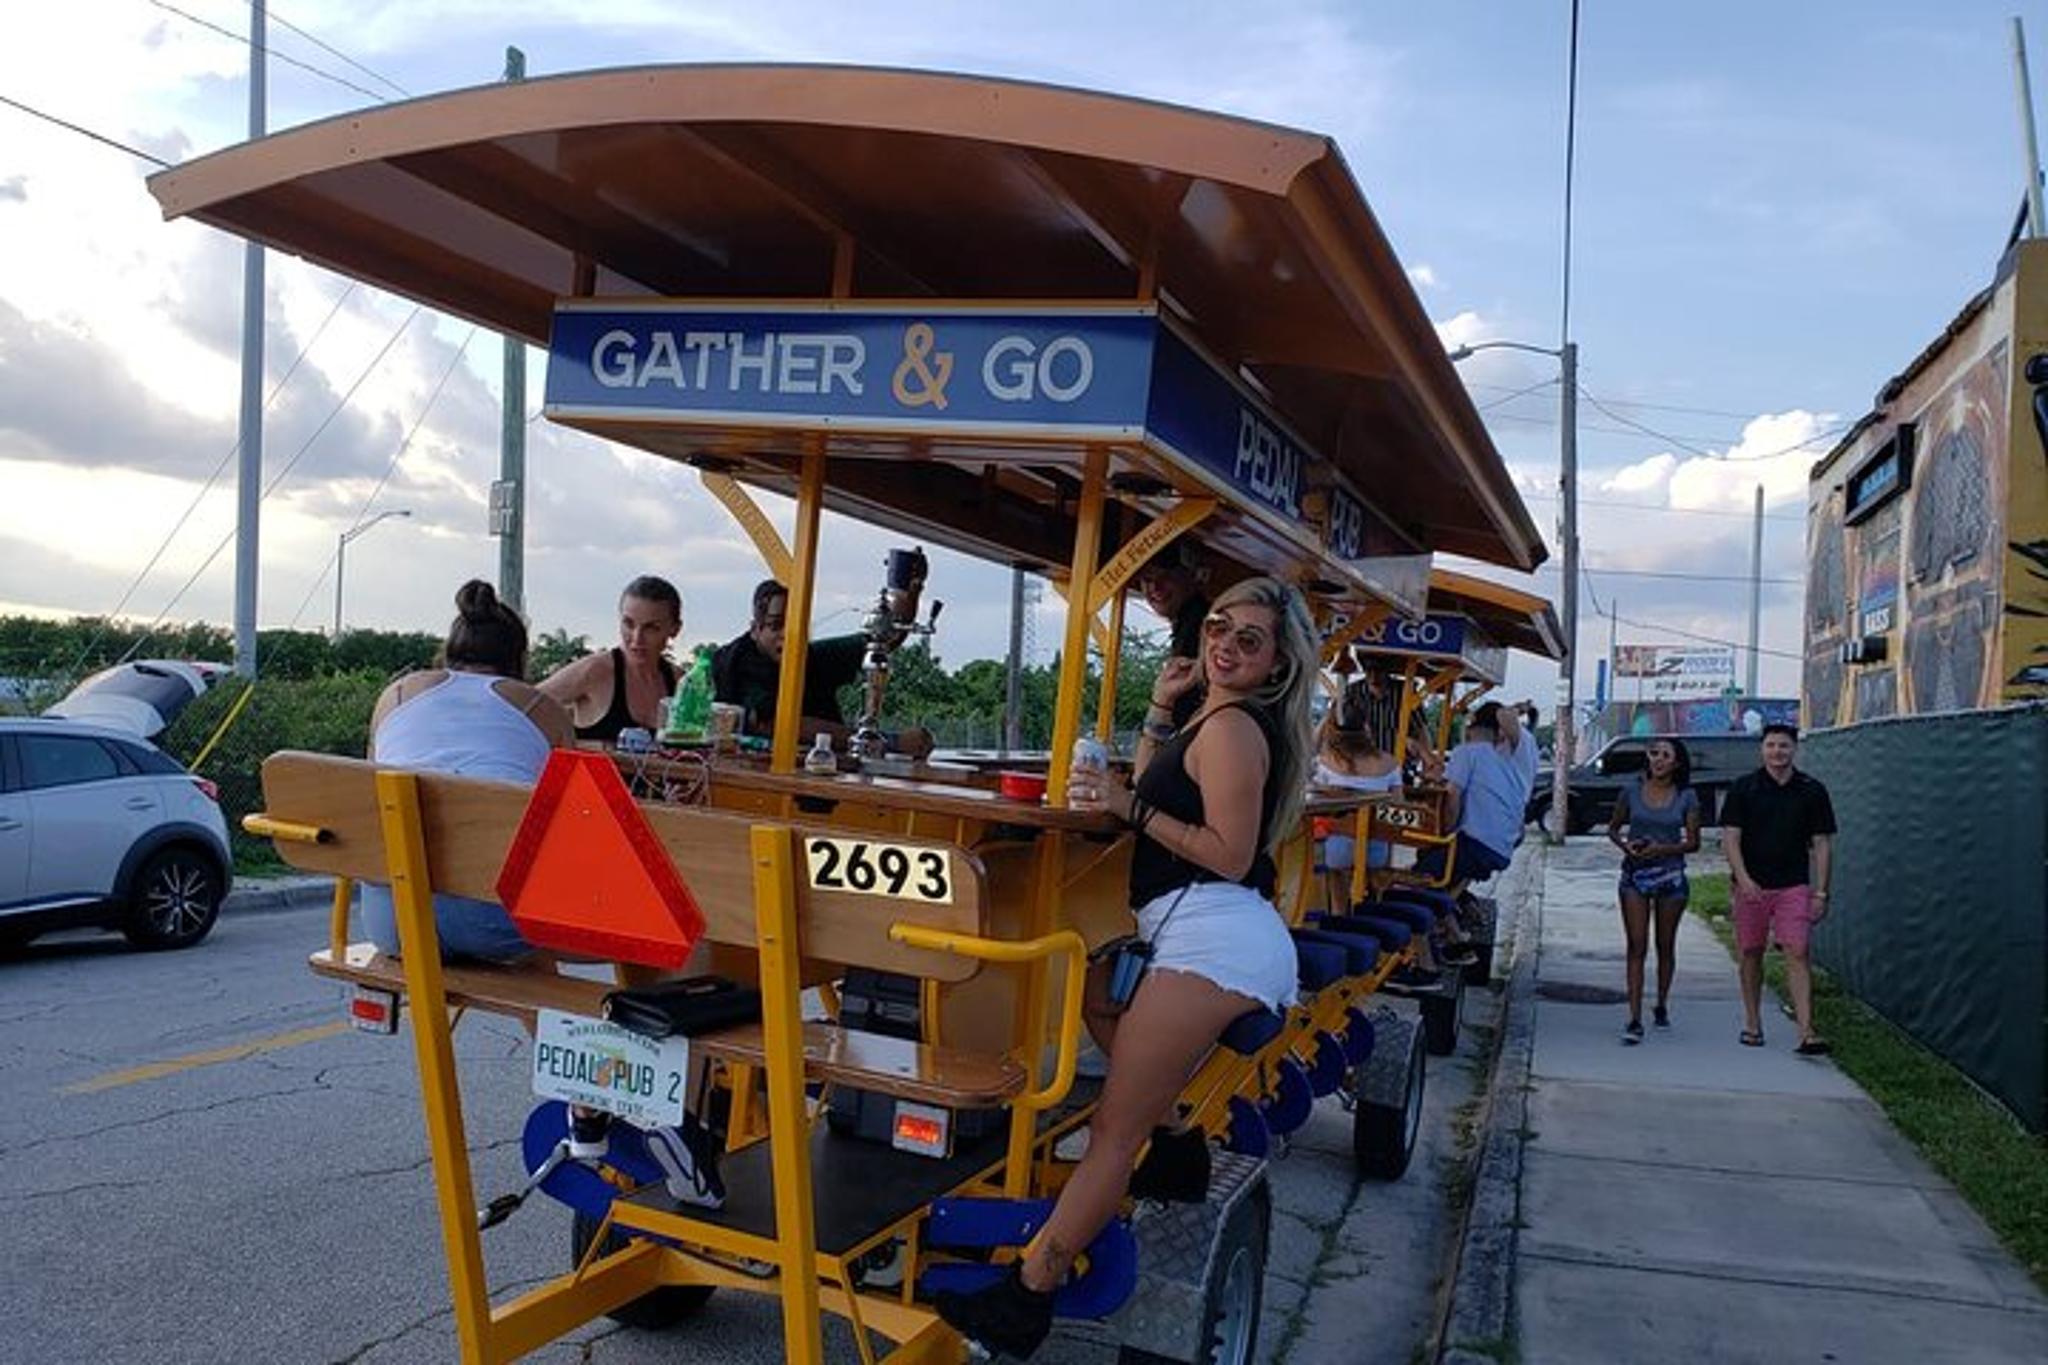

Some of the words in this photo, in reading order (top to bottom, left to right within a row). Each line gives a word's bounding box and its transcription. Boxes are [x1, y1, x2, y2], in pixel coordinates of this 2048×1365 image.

[592, 329, 866, 395] GATHER
[891, 323, 954, 410] &
[983, 335, 1094, 402] GO
[1234, 407, 1301, 520] PEDAL
[1397, 619, 1442, 644] GO
[810, 840, 948, 899] 2693
[537, 1042, 597, 1087] PEDAL
[613, 1060, 655, 1096] PUB
[667, 1071, 682, 1104] 2
